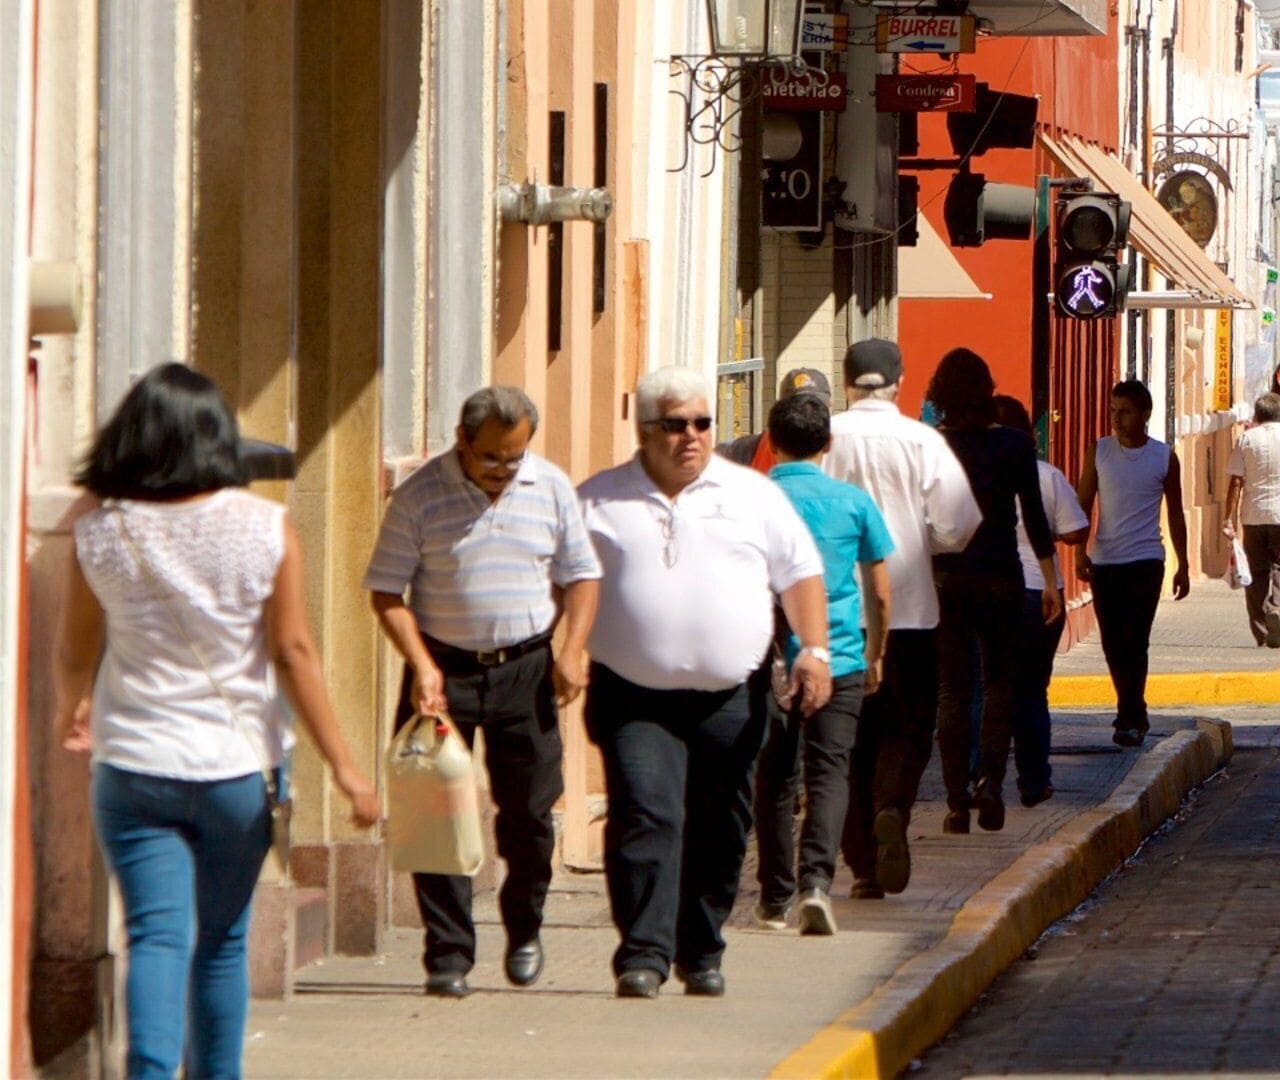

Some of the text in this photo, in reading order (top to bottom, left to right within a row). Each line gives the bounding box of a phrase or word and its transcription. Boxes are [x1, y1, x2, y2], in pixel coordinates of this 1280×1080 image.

[888, 19, 960, 38] BURREL
[897, 83, 955, 98] Condesa
[1218, 337, 1228, 403] EXCHANGE
